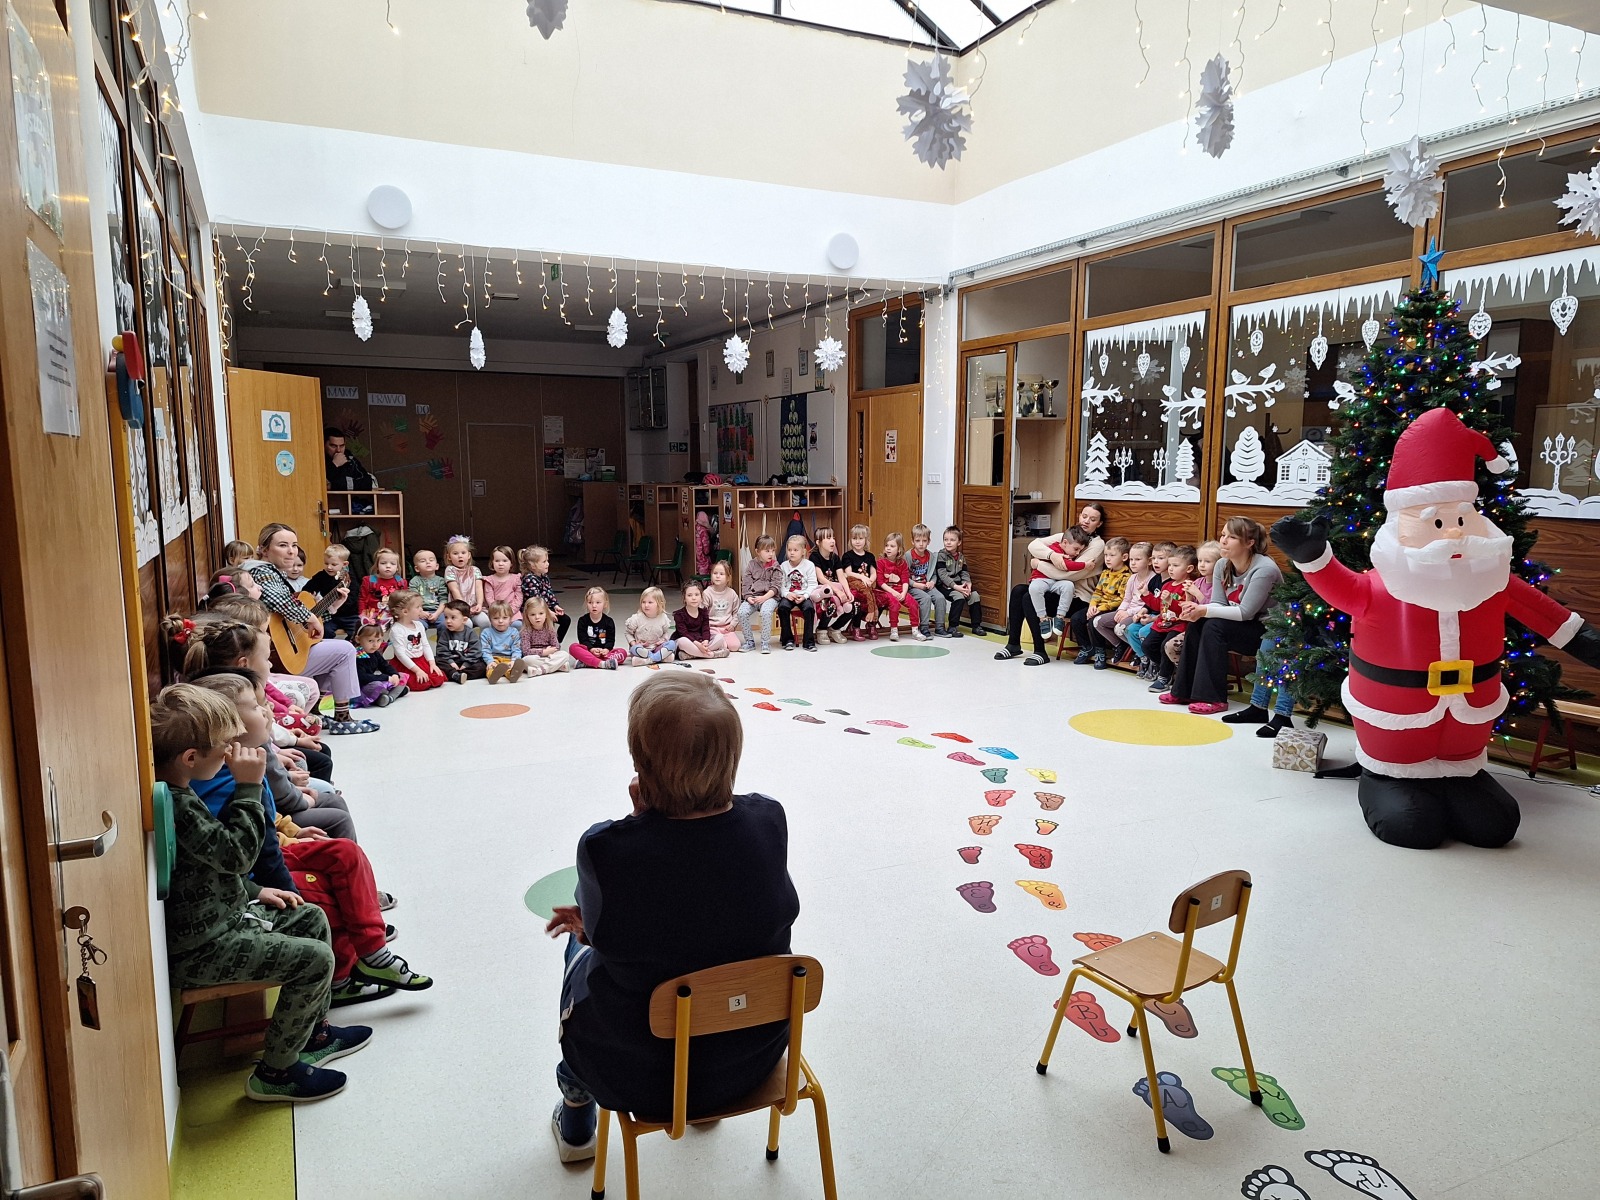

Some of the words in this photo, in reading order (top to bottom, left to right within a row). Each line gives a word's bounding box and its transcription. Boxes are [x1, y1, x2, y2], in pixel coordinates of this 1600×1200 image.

[327, 387, 358, 398] MAMY
[970, 888, 984, 898] E
[734, 998, 741, 1007] 3
[1071, 1004, 1098, 1020] B
[1088, 1021, 1108, 1037] b
[1174, 1024, 1190, 1033] c
[1162, 1088, 1187, 1108] A
[1181, 1121, 1206, 1132] a
